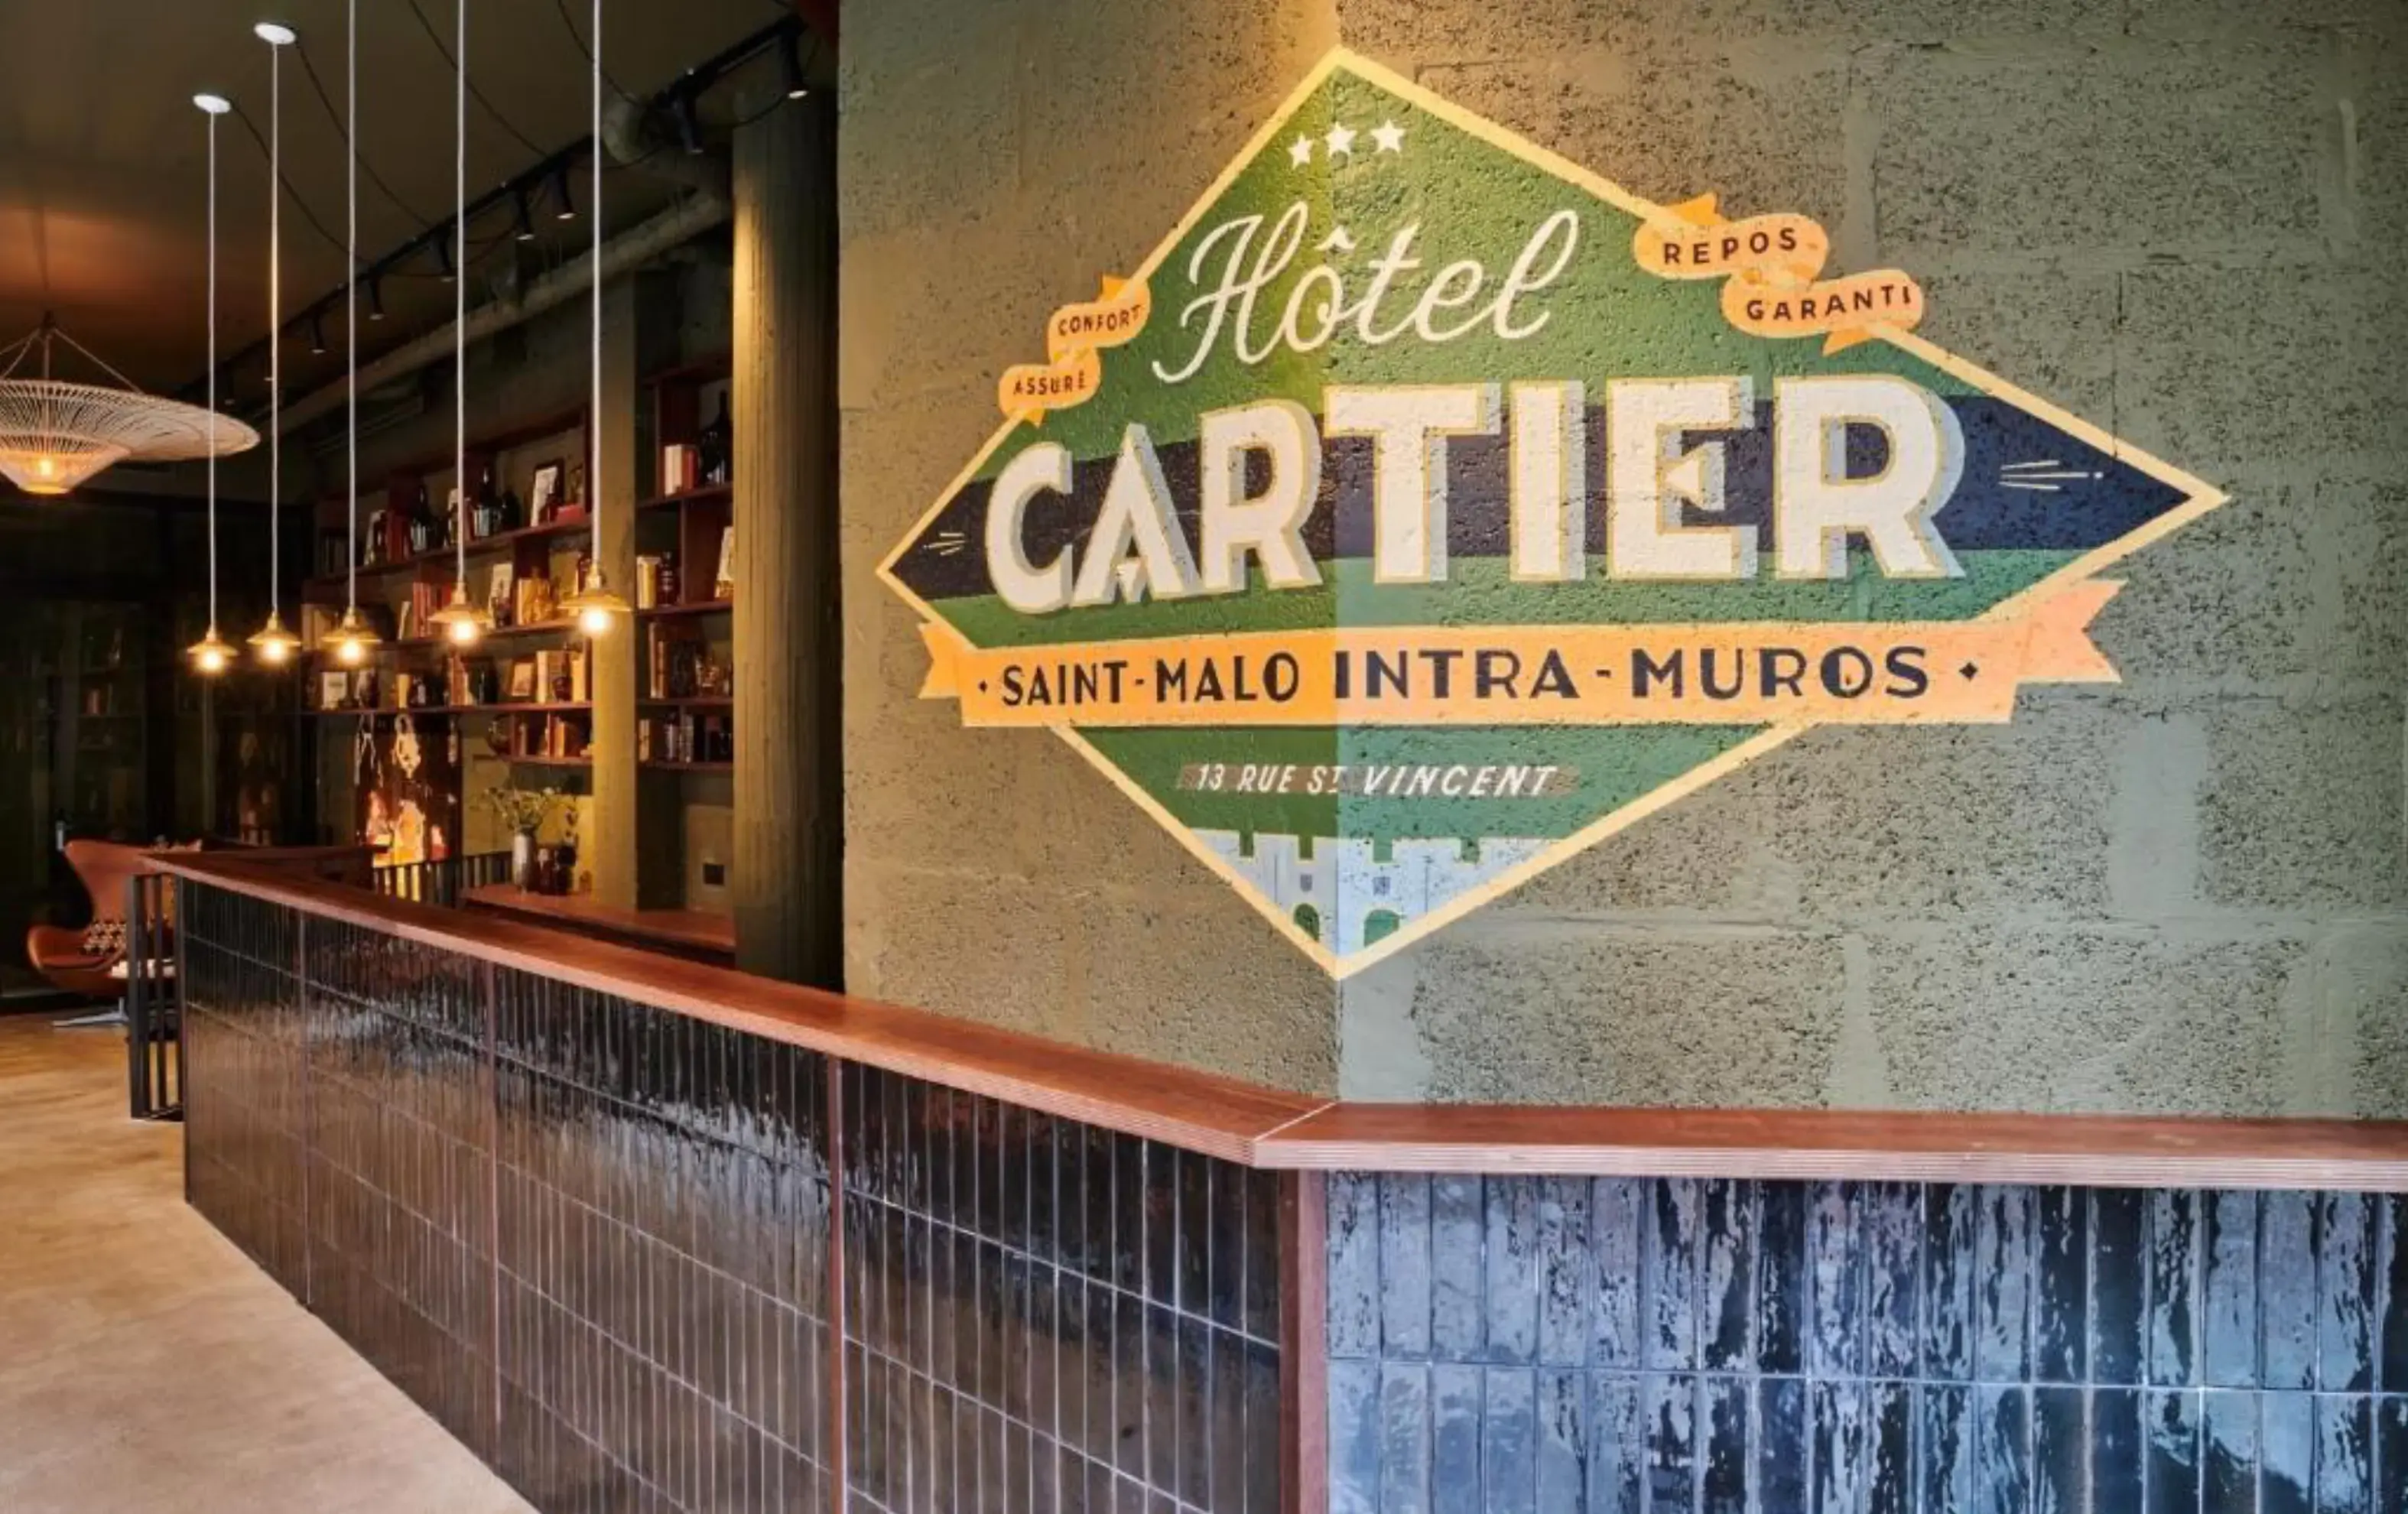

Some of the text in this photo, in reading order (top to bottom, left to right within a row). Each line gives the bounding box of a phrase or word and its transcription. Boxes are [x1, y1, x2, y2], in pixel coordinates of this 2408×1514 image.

[1663, 227, 1797, 265] REPOS
[1152, 200, 1578, 382] Hôtel
[1746, 285, 1912, 321] GARANTI
[1058, 304, 1142, 336] CONFORT
[985, 375, 1967, 613] CARTIER
[1002, 651, 1299, 707] SAINT-MALO
[1197, 764, 1225, 791] 13
[1236, 765, 1298, 793] RUE
[1363, 765, 1558, 797] VINCENT
